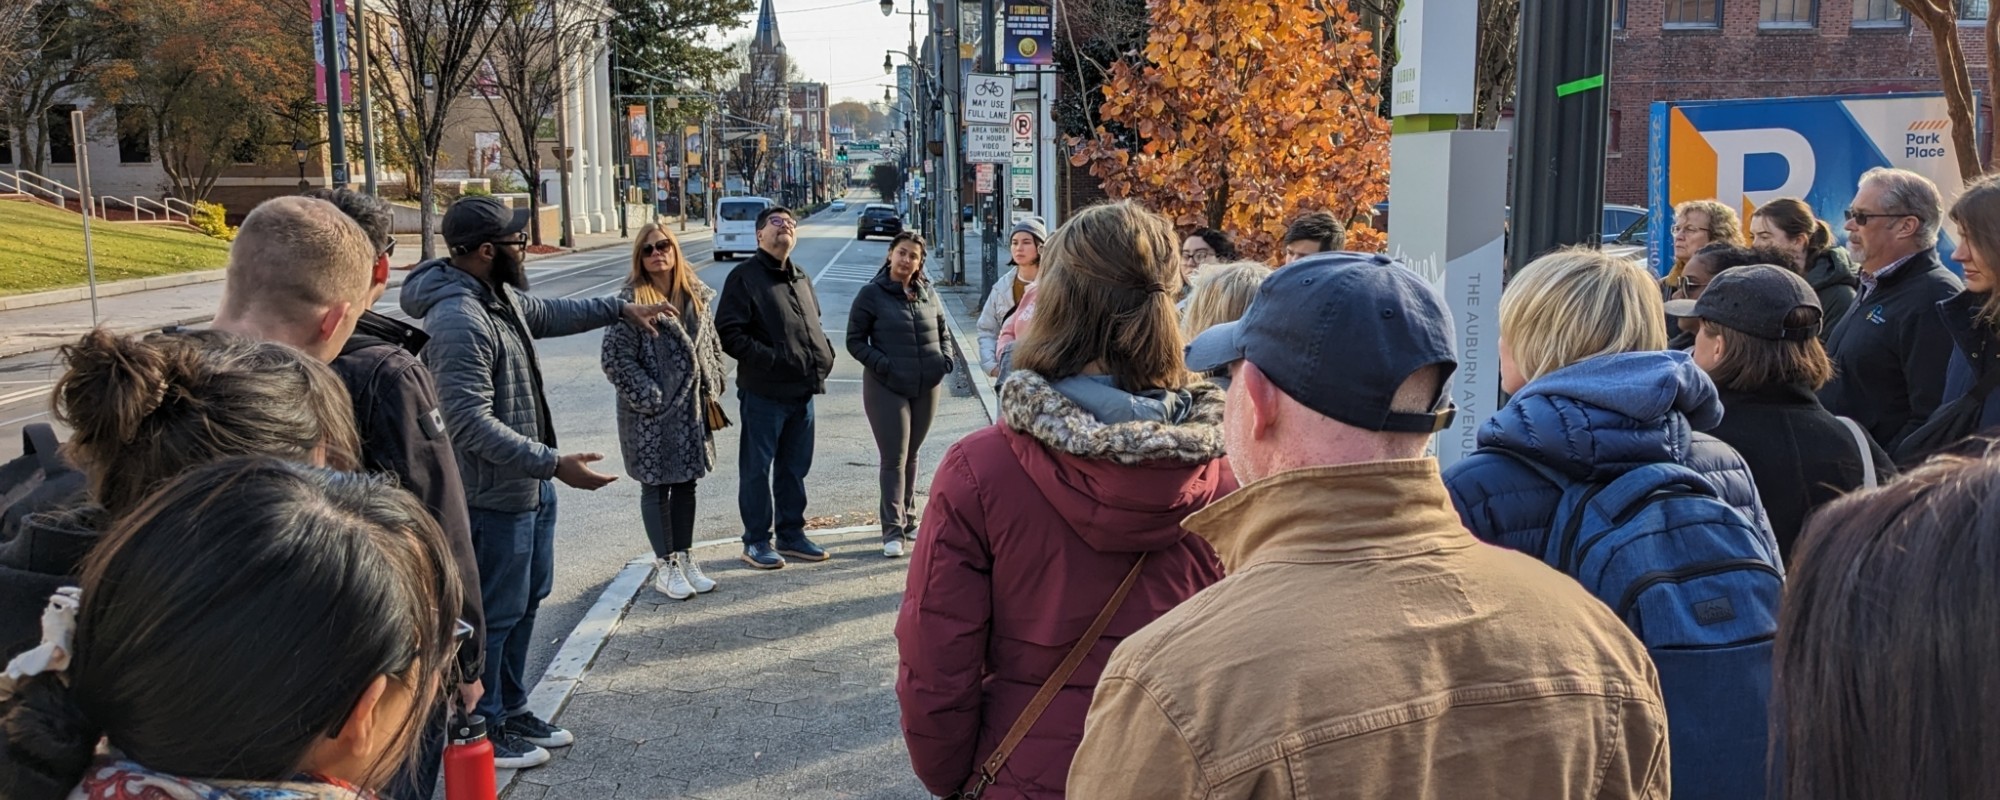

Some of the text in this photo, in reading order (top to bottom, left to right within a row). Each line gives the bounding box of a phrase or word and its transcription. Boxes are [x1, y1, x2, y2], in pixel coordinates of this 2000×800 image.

[972, 98, 1005, 108] MAY USE
[968, 109, 1008, 119] FULL LANE
[990, 126, 1010, 134] UNDER
[1905, 132, 1940, 145] Park
[1905, 146, 1945, 159] Place
[1467, 273, 1480, 307] THE
[1463, 311, 1479, 384] AUBURN
